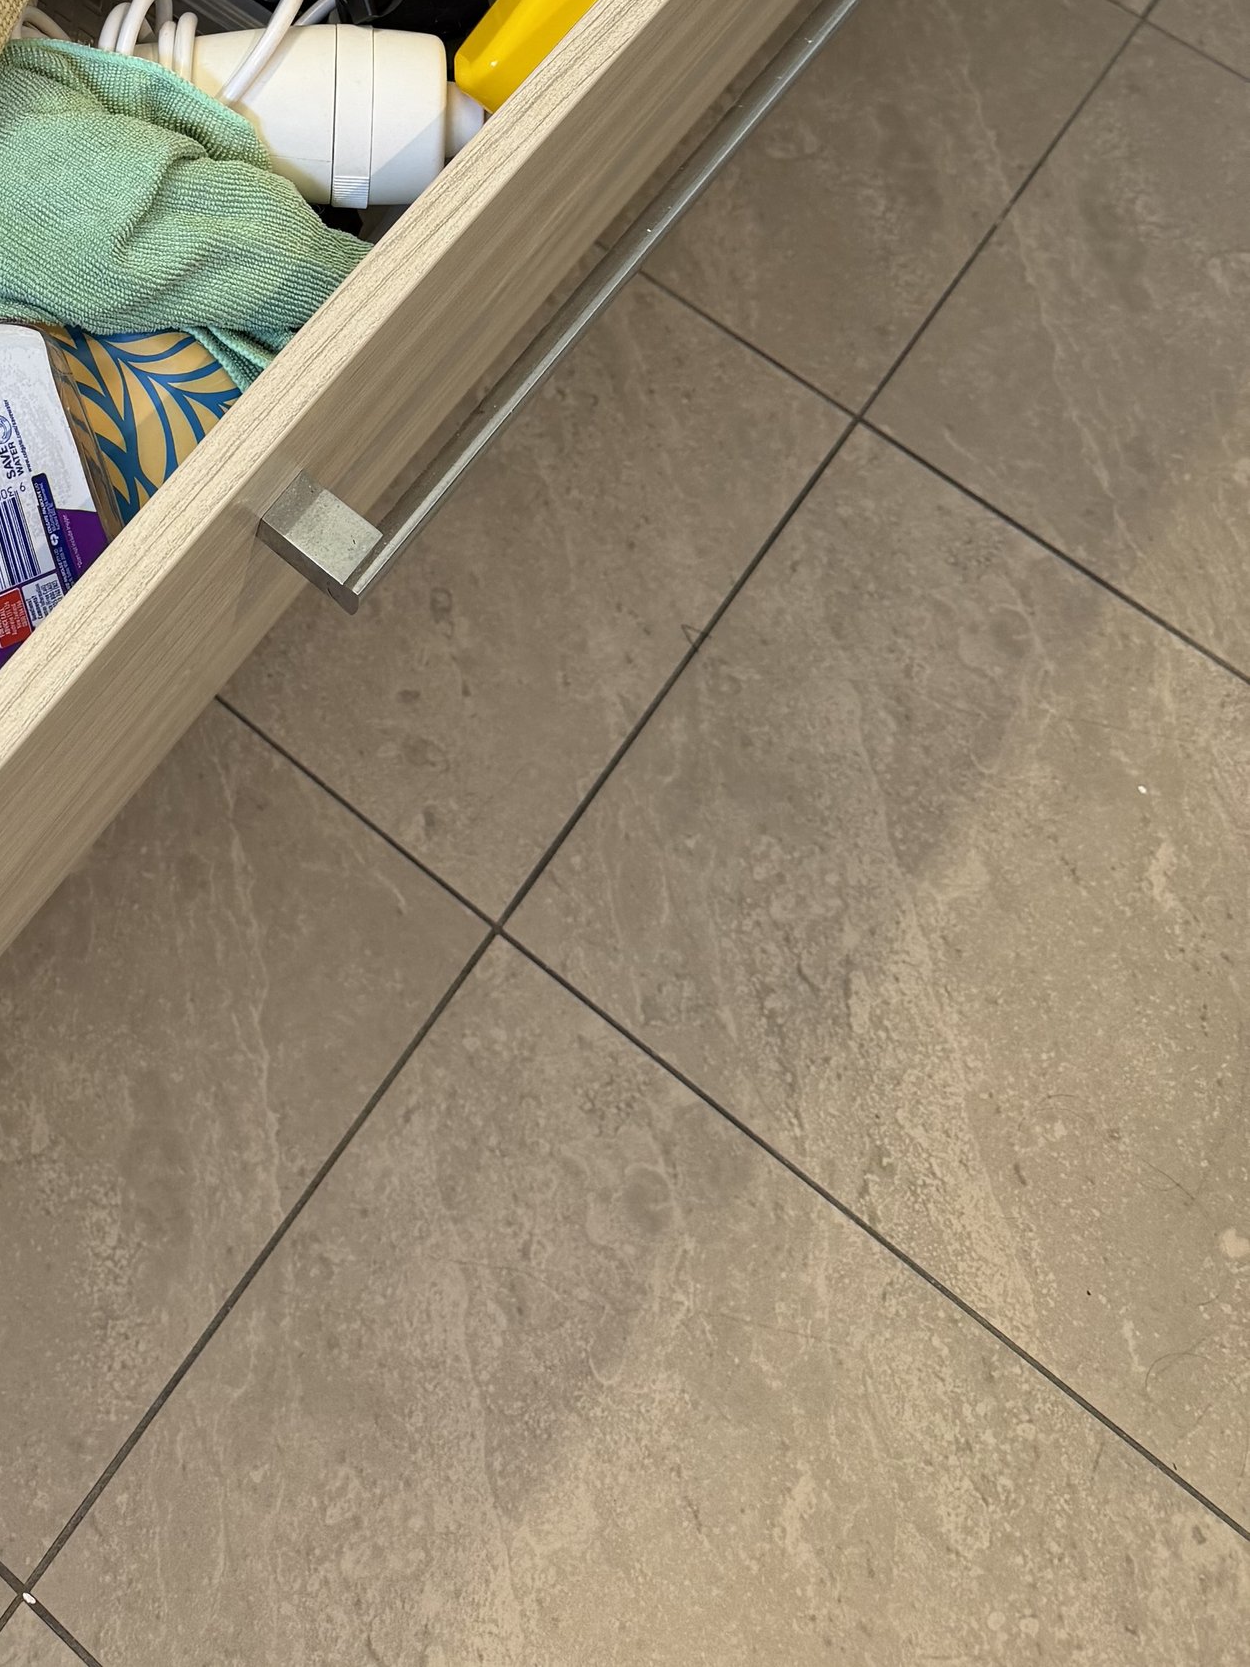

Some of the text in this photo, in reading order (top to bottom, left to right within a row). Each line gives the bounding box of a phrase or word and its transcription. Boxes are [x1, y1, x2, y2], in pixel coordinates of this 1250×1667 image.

[0, 447, 18, 480] SAVE
[11, 441, 24, 476] WATER
[20, 482, 26, 491] 9
